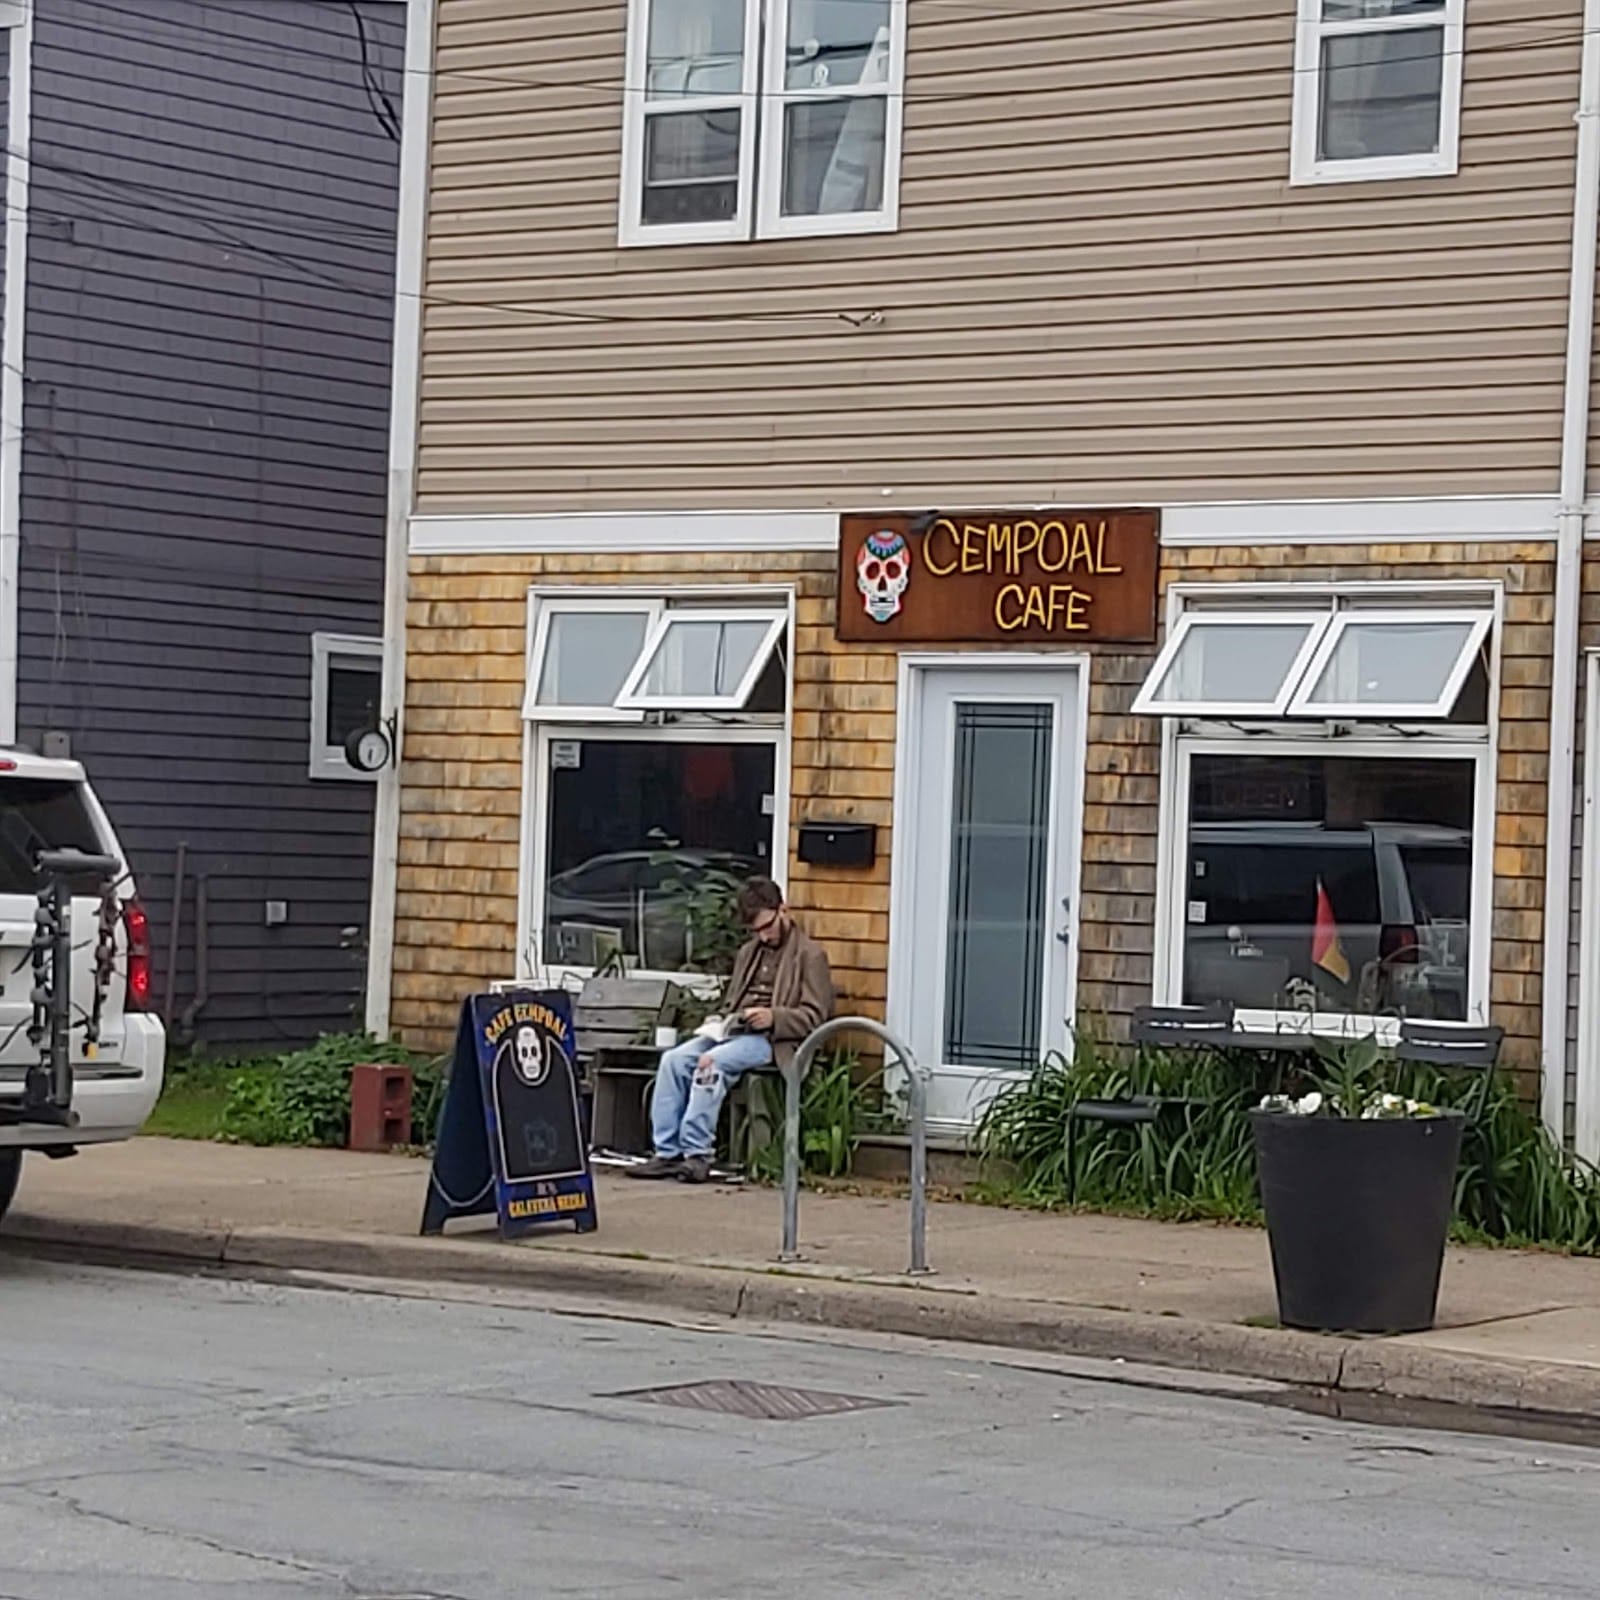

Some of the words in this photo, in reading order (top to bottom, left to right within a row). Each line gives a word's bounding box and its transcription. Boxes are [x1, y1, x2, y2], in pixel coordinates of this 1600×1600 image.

[922, 518, 1122, 575] CEMPOAL
[995, 583, 1092, 630] CAFE
[485, 1007, 514, 1044] CAFE
